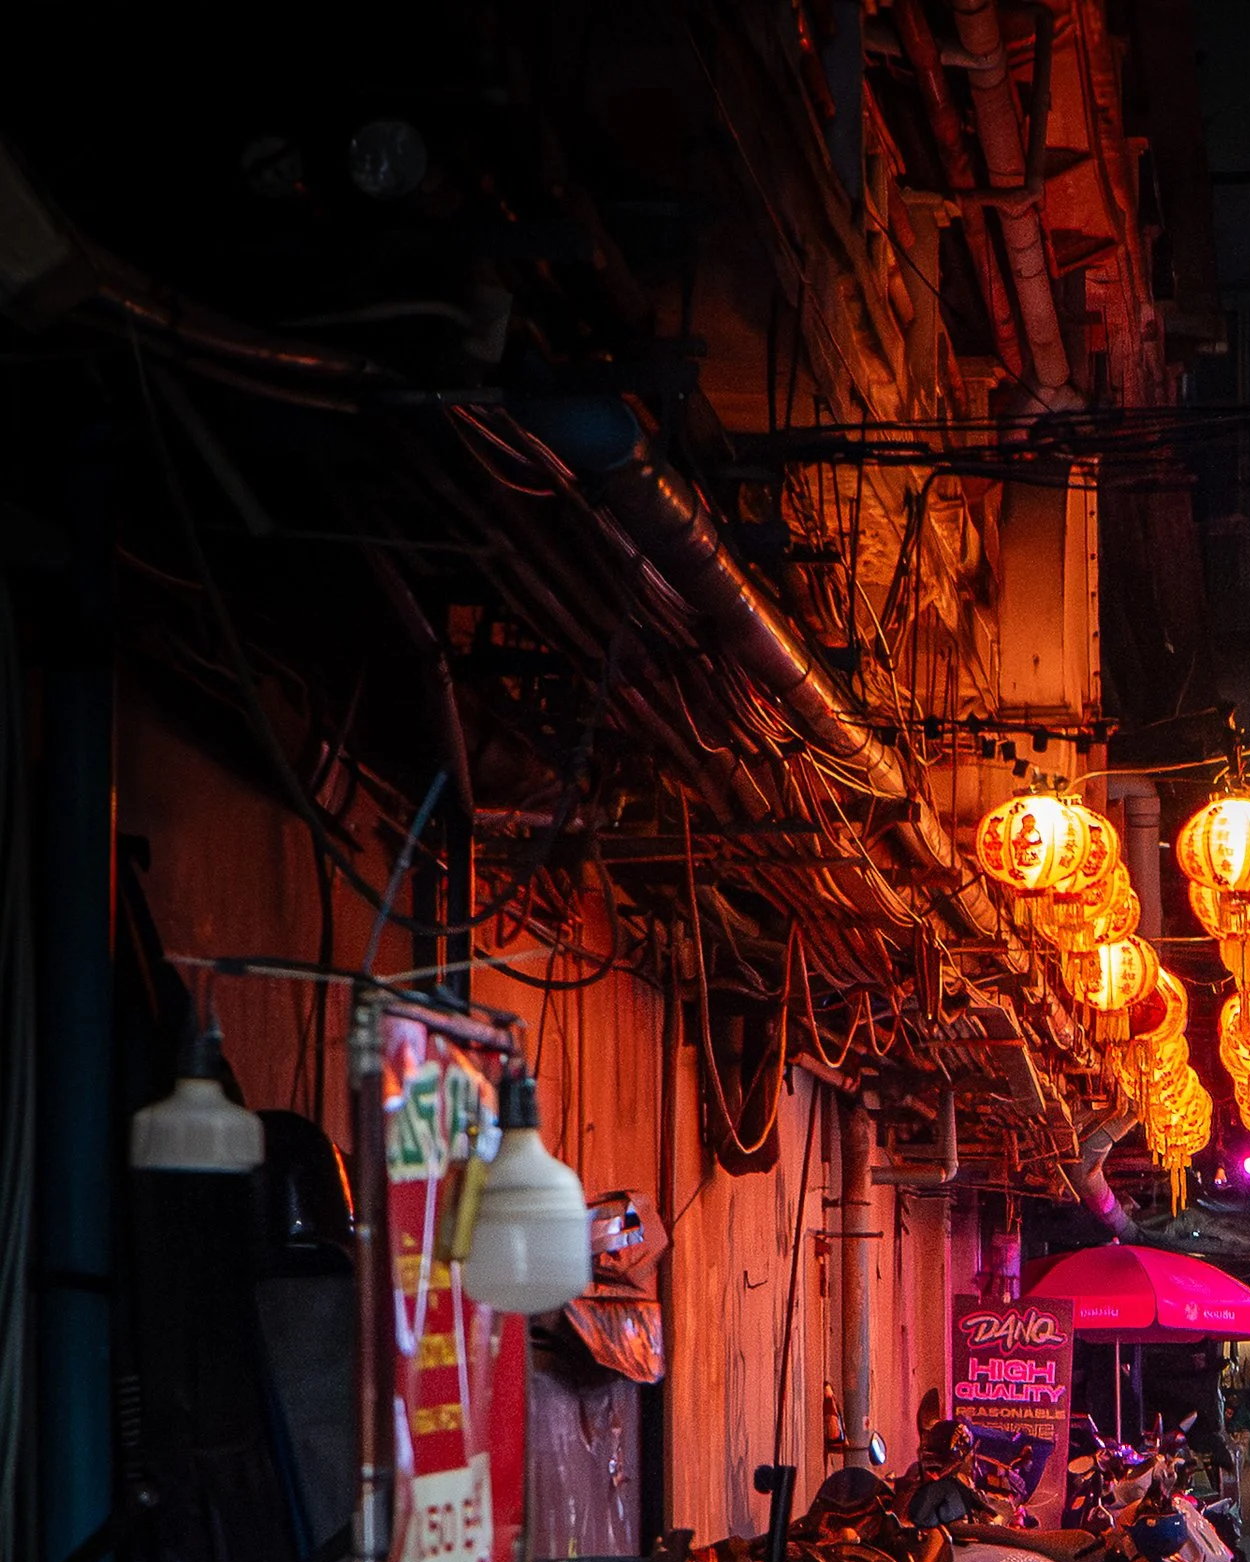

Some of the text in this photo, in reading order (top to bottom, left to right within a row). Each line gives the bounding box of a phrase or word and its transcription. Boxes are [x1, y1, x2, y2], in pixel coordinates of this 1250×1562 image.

[963, 1308, 1066, 1353] DANQ
[968, 1357, 1056, 1384] HIGH
[954, 1382, 1066, 1403] QUALITY
[955, 1406, 1067, 1420] REASONABLE
